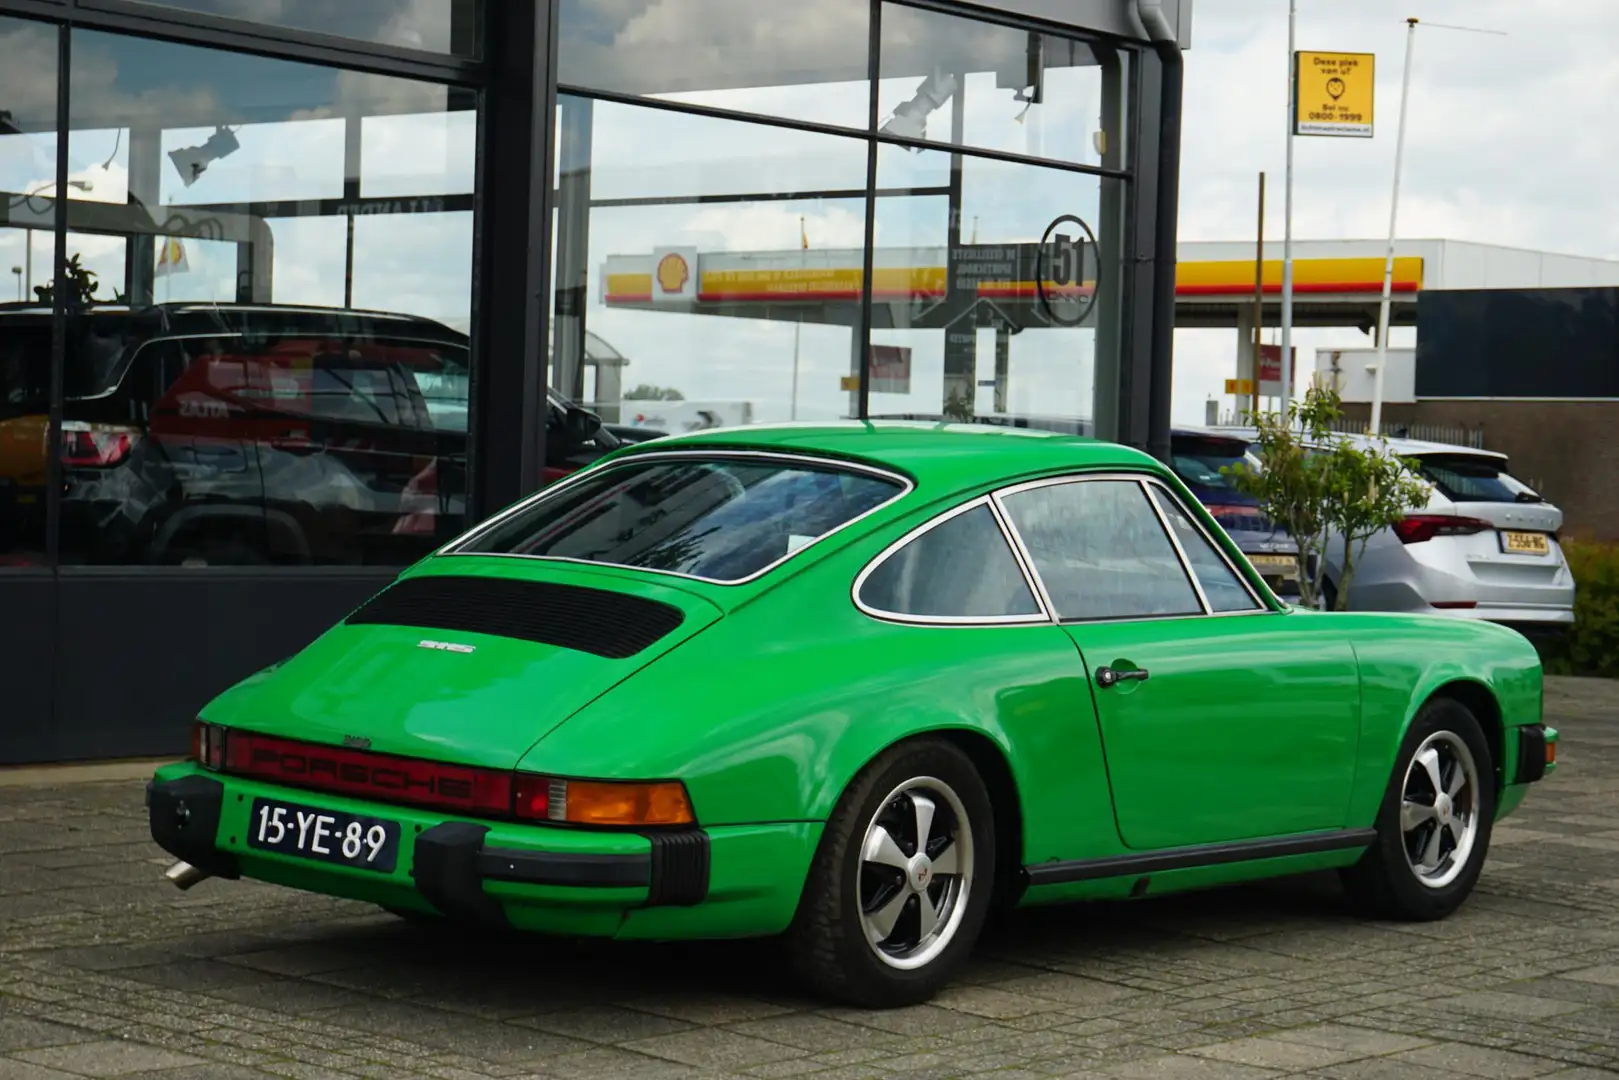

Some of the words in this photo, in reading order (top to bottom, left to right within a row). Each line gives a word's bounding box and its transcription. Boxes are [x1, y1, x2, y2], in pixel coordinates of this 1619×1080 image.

[1313, 57, 1337, 66] Deze
[1053, 232, 1085, 288] 51
[253, 748, 472, 799] PORSCHE
[257, 805, 387, 863] 15-YE-89
